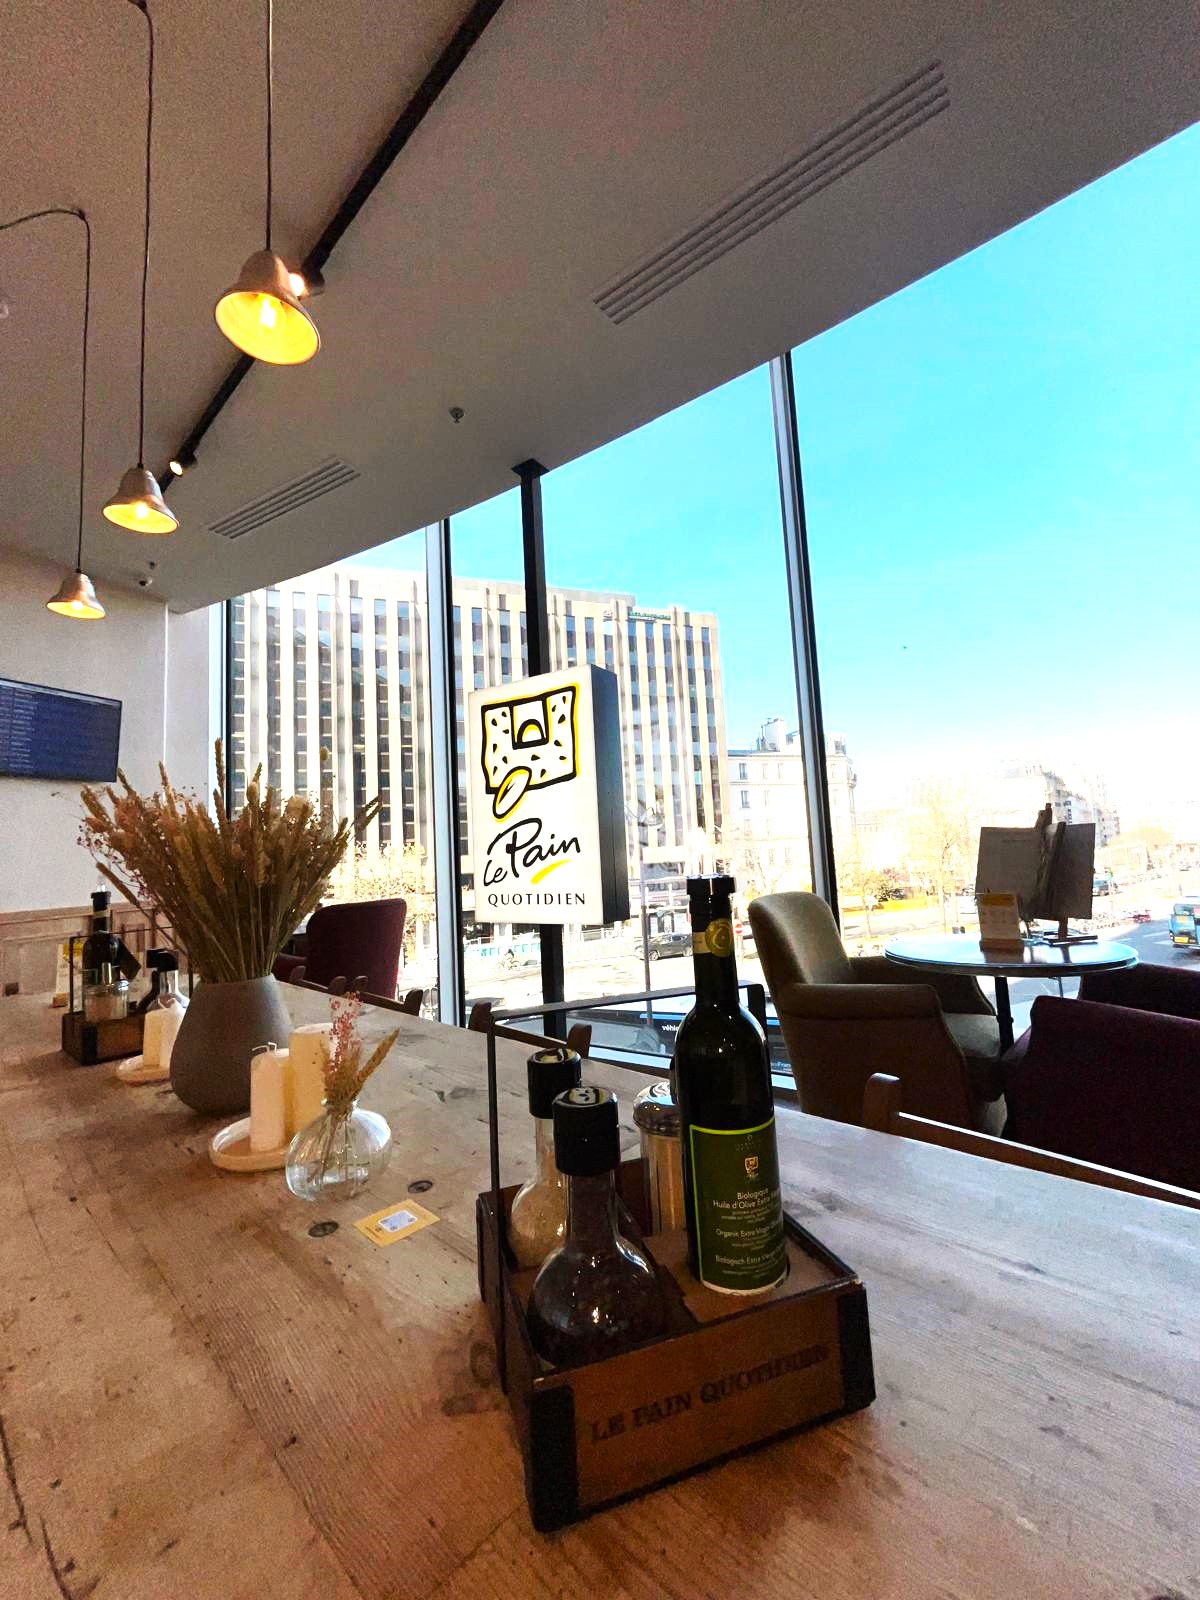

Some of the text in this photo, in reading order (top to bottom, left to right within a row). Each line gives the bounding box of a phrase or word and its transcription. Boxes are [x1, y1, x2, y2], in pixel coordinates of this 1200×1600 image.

[487, 817, 581, 878] Pain
[487, 892, 586, 908] QUOTIDIEN
[737, 1187, 769, 1200] Biologique
[713, 1199, 731, 1209] Huile
[590, 1413, 625, 1442] LE
[632, 1391, 692, 1428] PAIN
